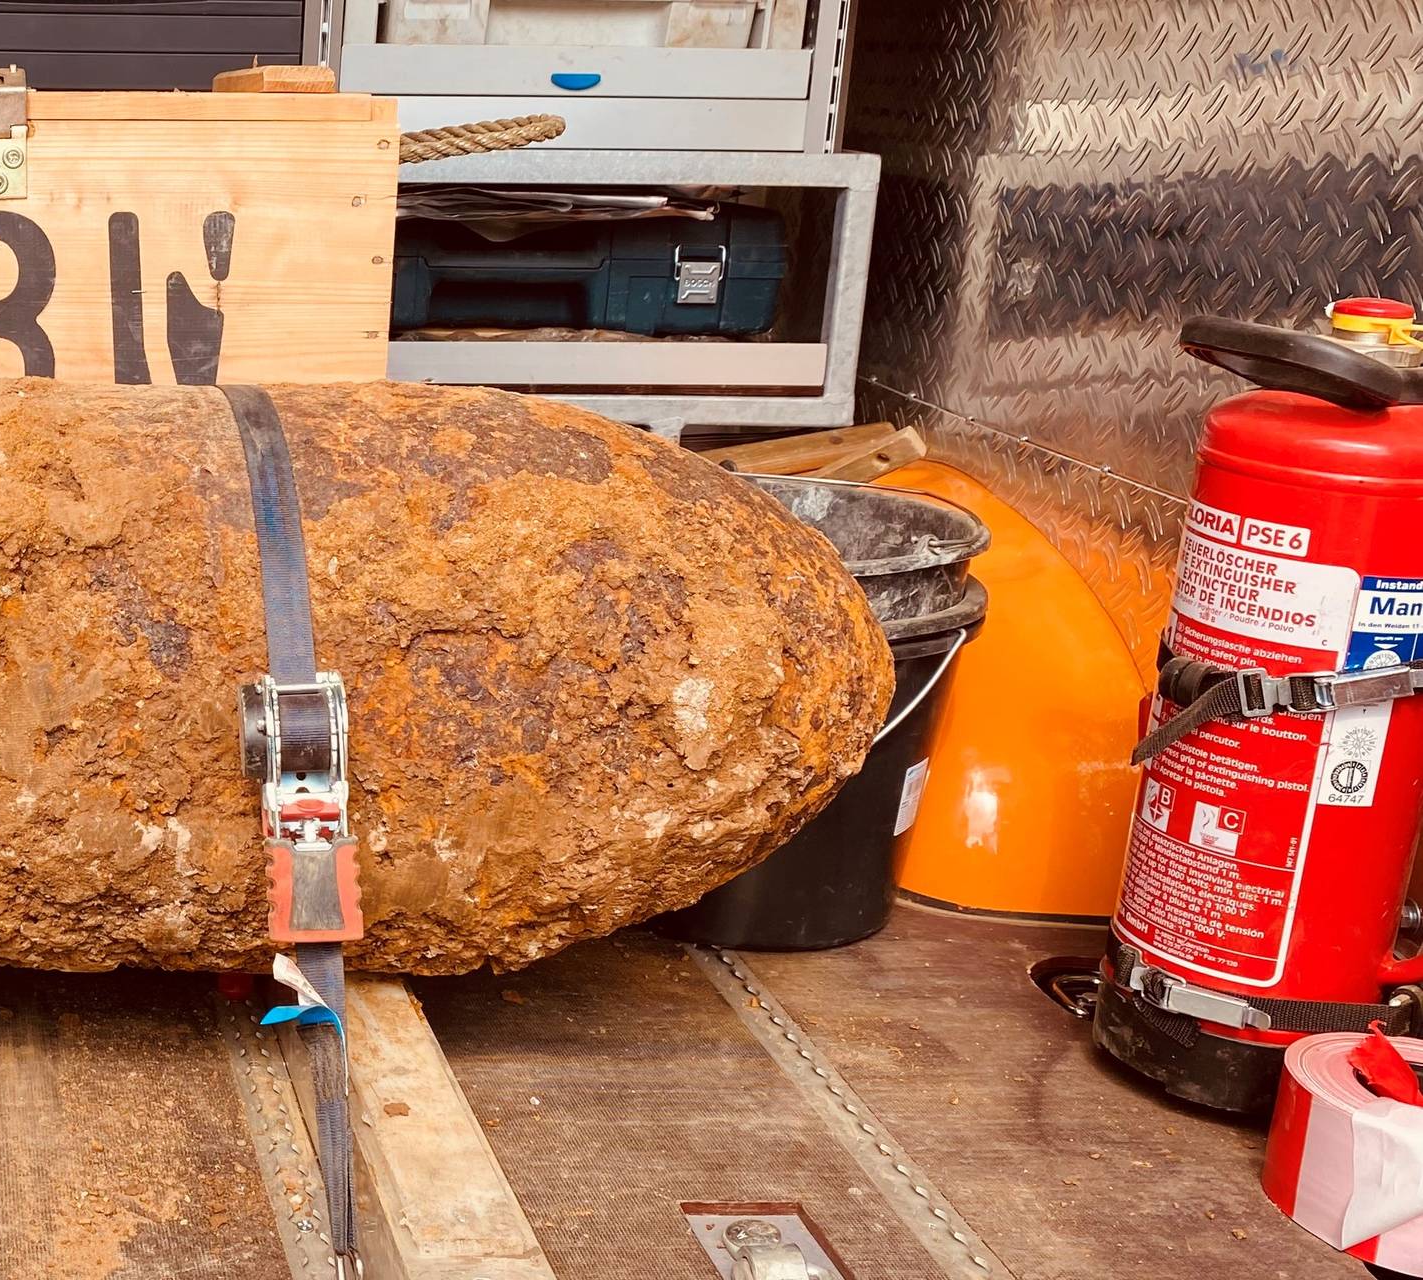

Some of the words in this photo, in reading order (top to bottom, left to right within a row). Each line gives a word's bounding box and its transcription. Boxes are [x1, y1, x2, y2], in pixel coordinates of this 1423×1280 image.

[684, 278, 716, 289] BOSCH
[1246, 524, 1286, 547] PSE
[1288, 531, 1303, 550] 6
[1184, 537, 1279, 576] FEUERLÖSCHER
[1183, 567, 1260, 602] EXTINCTEUR
[1190, 554, 1297, 594] EXTINGUISHER
[1199, 590, 1216, 605] DE
[1220, 595, 1318, 627] INCENDIOS
[1229, 612, 1259, 626] Poudre
[1268, 622, 1295, 633] Polvo
[1182, 636, 1210, 653] Remove
[1211, 646, 1239, 663] safety
[1240, 654, 1259, 667] pin.
[1184, 624, 1252, 653] Sicherungslasche
[1253, 647, 1304, 665] abziehen.
[1199, 731, 1241, 749] percutor.
[1231, 720, 1248, 730] sur
[1249, 723, 1260, 733] le
[1262, 728, 1307, 741] boutton
[1161, 755, 1185, 771] Presser
[1185, 765, 1193, 775] la
[1180, 753, 1195, 766] grip
[1196, 760, 1206, 769] of
[1208, 764, 1275, 788] extinguishing
[1277, 780, 1309, 792] pistol.
[1209, 752, 1260, 773] betätigen.
[1159, 766, 1184, 783] Apretar
[1184, 776, 1193, 786] la
[1193, 781, 1227, 798] pistola.
[1161, 787, 1172, 805] B
[1328, 793, 1365, 804] 64747
[1223, 812, 1239, 829] C
[1152, 832, 1197, 858] elektrischen
[1198, 853, 1239, 871] Anlagen.
[1154, 841, 1219, 874] Mindestabstand
[1148, 856, 1157, 870] up
[1157, 861, 1166, 873] to
[1167, 866, 1185, 882] 1000
[1213, 882, 1235, 897] min.
[1238, 890, 1260, 903] dist.
[1150, 865, 1197, 895] installations
[1198, 890, 1257, 912] électriques.
[1156, 851, 1169, 863] for
[1168, 856, 1187, 873] fires
[1188, 867, 1234, 889] involving
[1235, 882, 1285, 898] electrical
[1161, 882, 1204, 905] inférieure
[1214, 902, 1237, 915] 1000
[1168, 895, 1187, 910] plus
[1188, 902, 1202, 913] de
[1164, 902, 1208, 925] presencia
[1209, 917, 1223, 929] de
[1224, 921, 1265, 939] tensión
[1166, 909, 1192, 929] hasta
[1193, 921, 1215, 936] 1000
